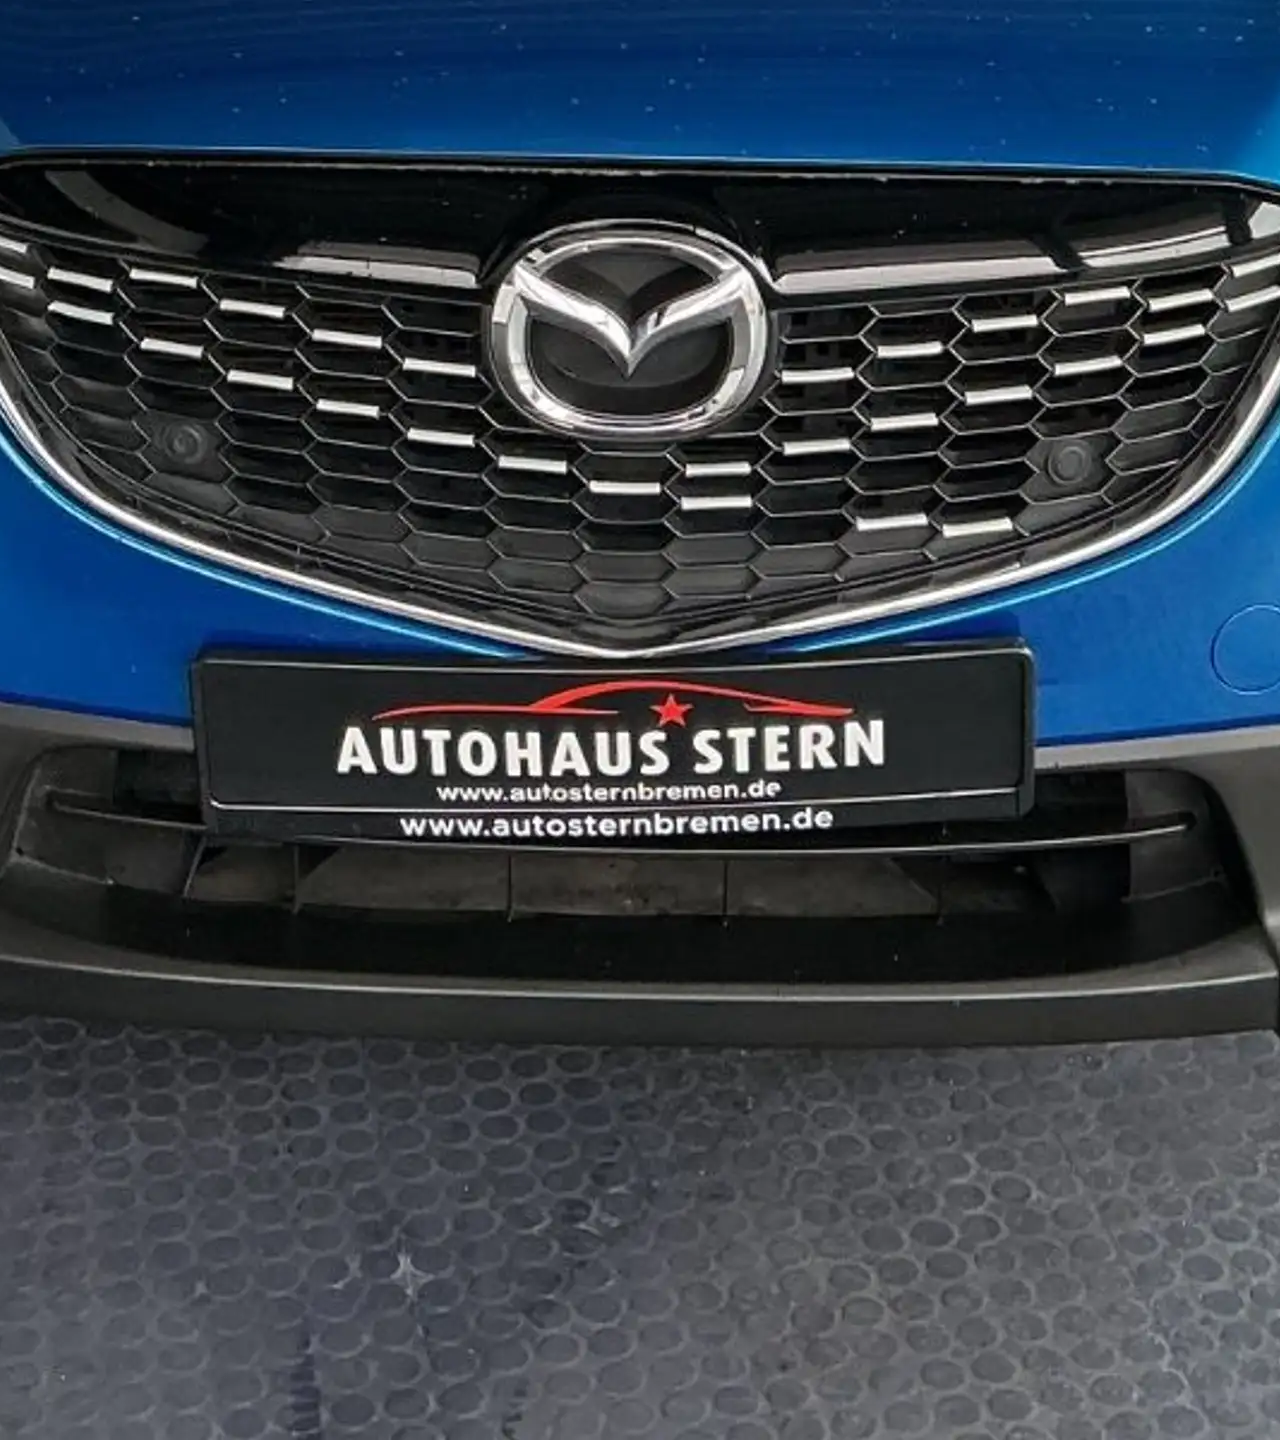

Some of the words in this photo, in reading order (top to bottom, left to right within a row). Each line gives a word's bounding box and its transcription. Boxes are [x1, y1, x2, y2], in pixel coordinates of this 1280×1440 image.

[336, 726, 670, 777] AUTOHAUS
[692, 720, 885, 774] STERN
[436, 779, 783, 802] www.autosternbremen.de
[399, 808, 834, 838] www.autosternbremen.de
